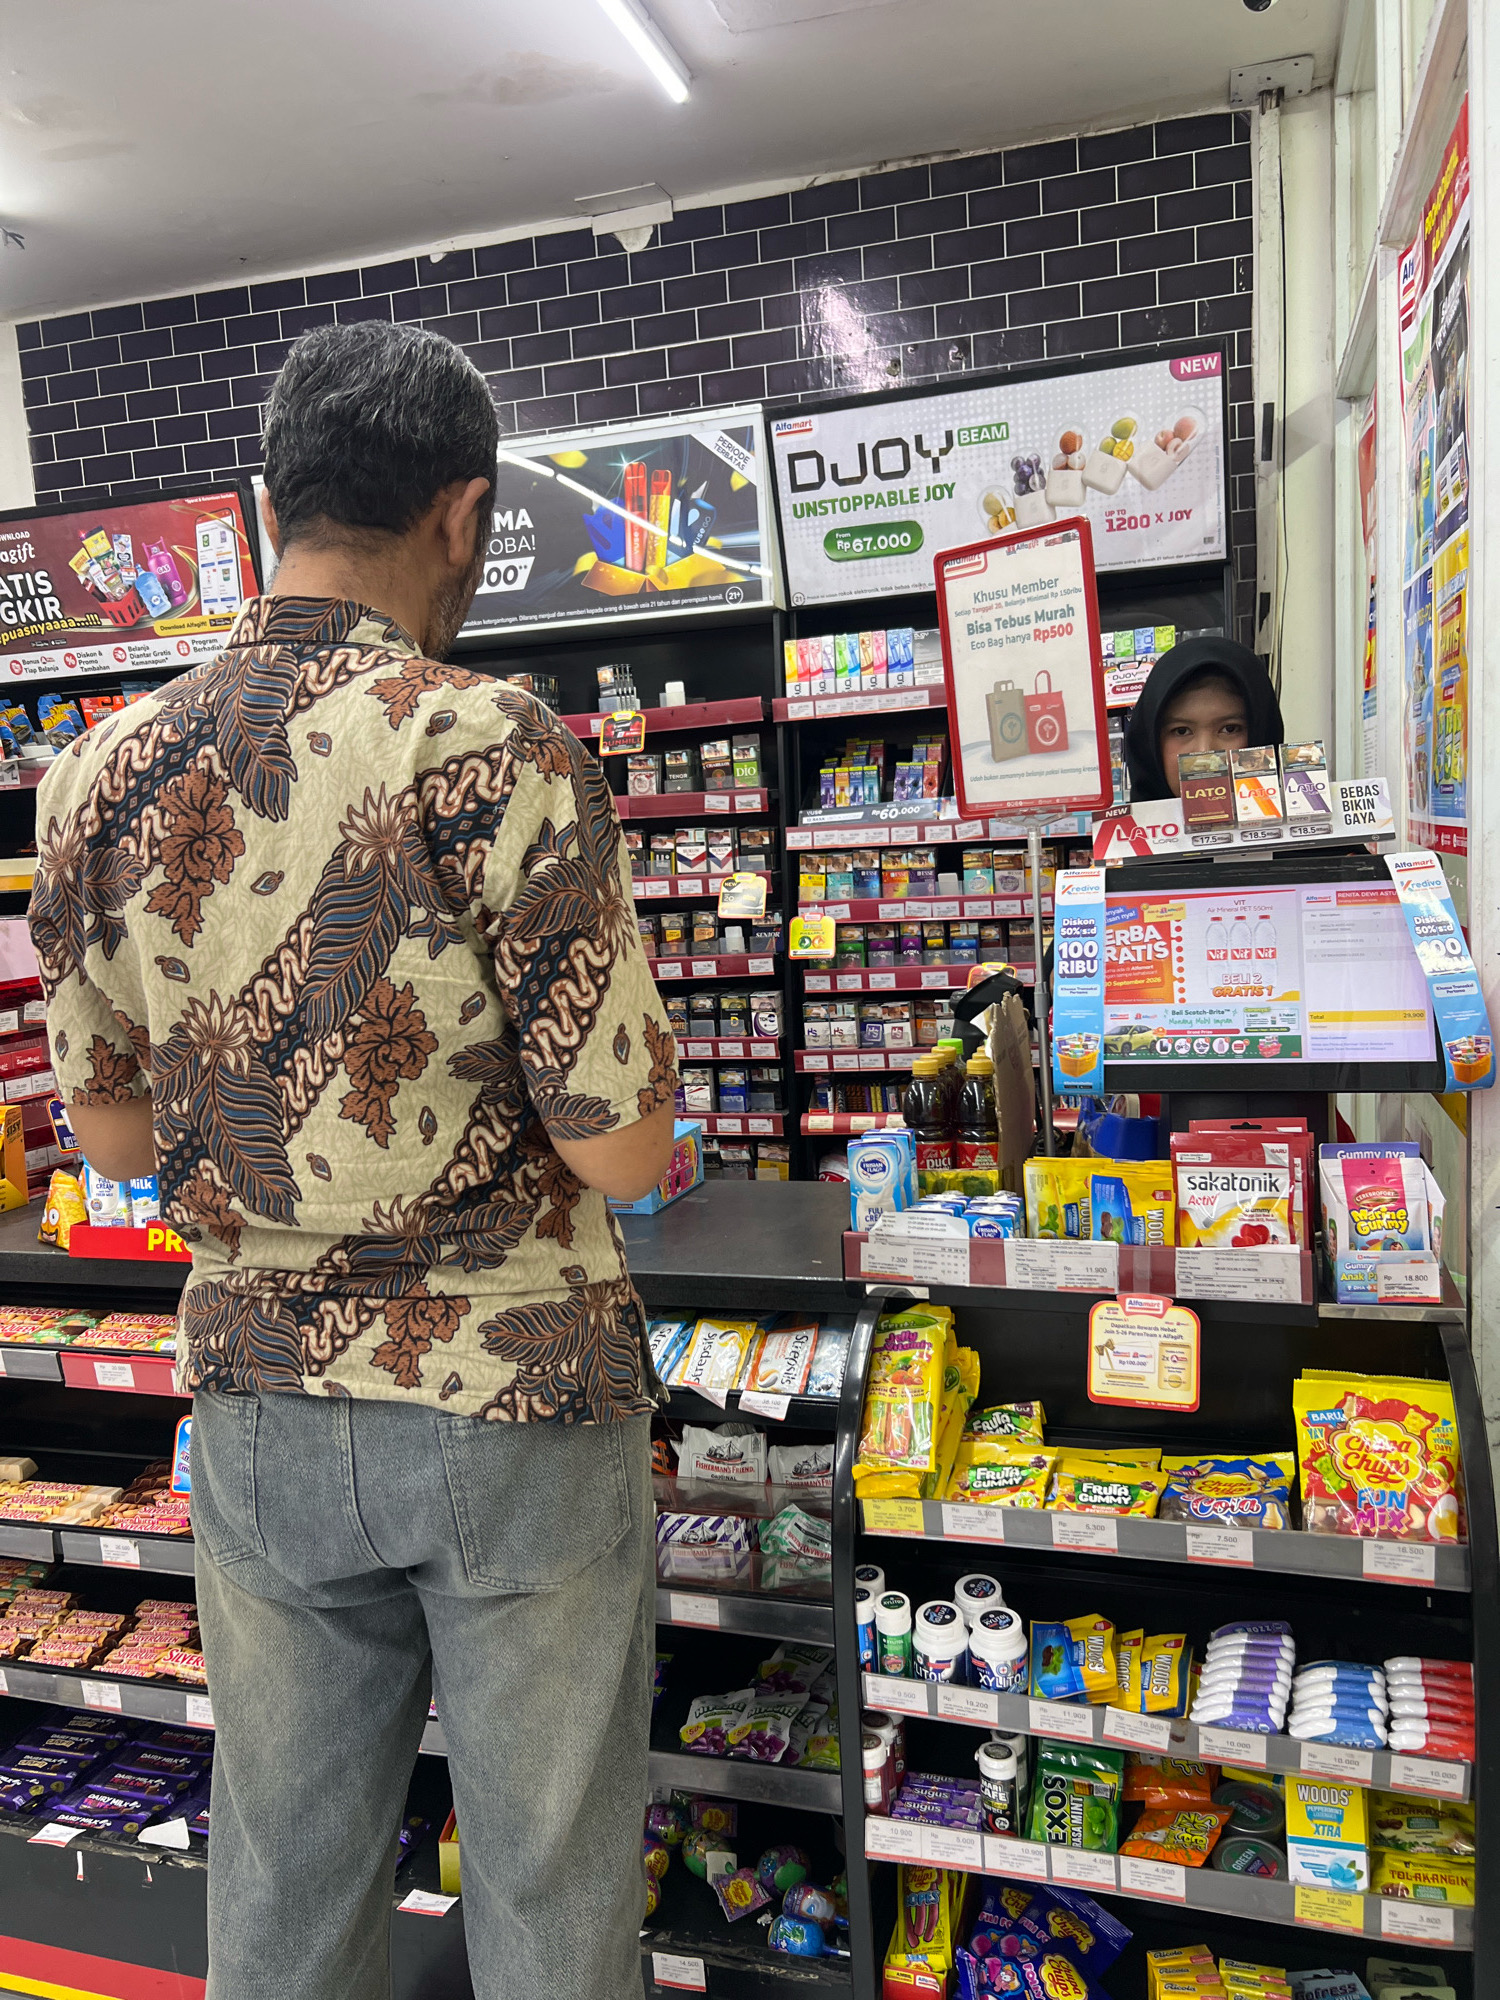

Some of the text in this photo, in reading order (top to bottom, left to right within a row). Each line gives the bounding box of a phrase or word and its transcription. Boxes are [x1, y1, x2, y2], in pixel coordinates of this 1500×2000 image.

[1178, 356, 1219, 375] NEW
[716, 434, 751, 465] PERIODE
[712, 442, 747, 472] TERBATAS
[787, 423, 1008, 494] DJOY BEAM
[791, 481, 957, 520] UNSTOPPABLE JOY
[1104, 508, 1194, 533] 1200 JOY
[156, 564, 170, 575] GAS
[973, 577, 1060, 604] Khusu Member
[954, 607, 972, 618] Setiap
[1004, 598, 1026, 608] Belanja
[1060, 587, 1082, 596] 150ribu
[967, 604, 1075, 636] Bisa Tebus Murah
[970, 622, 1074, 650] Eco Bag hanya Rp500
[191, 638, 219, 648] Program
[127, 645, 150, 655] Belanja
[192, 644, 224, 654] Berhadiah
[76, 651, 98, 659] Diskon
[129, 650, 172, 660] Diantar Gratis
[24, 667, 38, 675] Tiap
[80, 664, 111, 673] Tambahan
[735, 766, 756, 778] DIO
[1186, 786, 1227, 799] LATO
[1239, 787, 1277, 799] LATO
[1288, 782, 1326, 793] LATO
[1340, 784, 1381, 800] BEBAS
[1342, 799, 1376, 813] BIKIN
[1105, 806, 1129, 818] NEW
[1344, 812, 1377, 827] GAYA
[1248, 832, 1267, 840] 18.5
[1297, 827, 1316, 835] 18.5
[1200, 836, 1217, 844] 17.5
[1394, 858, 1434, 870] Alfamart
[1360, 890, 1379, 898] DEWI
[1120, 910, 1136, 920] nya!
[1062, 917, 1095, 926] Diskon
[1060, 926, 1081, 936] 50%
[1415, 924, 1437, 935] 50%
[1058, 940, 1099, 959] 100
[1232, 949, 1251, 960] Vit
[1257, 947, 1275, 959] Vit
[1208, 950, 1226, 961] Vit
[1058, 959, 1099, 975] RIBU
[1113, 978, 1145, 987] September
[1222, 973, 1263, 985] BELI 2
[1212, 985, 1273, 998] GRATIS 1
[1336, 1150, 1382, 1160] Gummy
[863, 1160, 884, 1170] FRISIAN
[866, 1165, 884, 1174] FLAG
[97, 1176, 112, 1185] FULL
[1187, 1172, 1280, 1193] sakatonik
[95, 1182, 115, 1191] CREAM
[868, 1207, 884, 1216] FULL
[1350, 1206, 1407, 1222] Marine
[1355, 1218, 1410, 1236] Gummy
[890, 1256, 908, 1264] 7.300
[1084, 1266, 1108, 1274] 11.900
[1344, 1261, 1376, 1272] Gummy
[1340, 1272, 1367, 1282] Anak
[1383, 1273, 1429, 1282] Rp 18.800
[1127, 1299, 1161, 1308] Alfamart
[79, 1327, 157, 1342] SILVERQUEEN
[780, 1333, 810, 1387] Strepsils
[1311, 1411, 1342, 1422] BARU
[1306, 1427, 1325, 1440] YAY
[695, 1459, 733, 1474] FISHERMAN'S
[1167, 1469, 1198, 1477] BARU
[972, 1476, 1023, 1490] GUMMY
[1078, 1492, 1132, 1506] GUMMY
[1356, 1487, 1407, 1511] FUN
[1188, 1495, 1262, 1518] Cola
[1085, 1523, 1106, 1532] 5.300
[1216, 1535, 1238, 1543] 7.500
[883, 1597, 905, 1606] XYLITOL
[130, 1634, 180, 1644] SILVERQUEEN
[114, 1772, 155, 1786] DAIRY MILK
[919, 1773, 954, 1784] sugus
[913, 1787, 949, 1799] sugus
[1296, 1783, 1353, 1807] WOODS'
[88, 1792, 129, 1808] DAIRY MILK
[904, 1801, 942, 1814] sugus
[1306, 1805, 1343, 1816] PEPPERMINT
[57, 1812, 98, 1826] DAIRY MILK
[1069, 1793, 1084, 1849] RASA MINT
[890, 1827, 913, 1837] 10.900
[1312, 1822, 1343, 1839] XTRA
[956, 1836, 975, 1845] 5.000
[1091, 1856, 1113, 1866] 4.000
[1153, 1866, 1176, 1876] 4.500
[1153, 1950, 1183, 1960] Ricola
[1158, 1966, 1191, 1976] Ricola
[1163, 1982, 1198, 1993] Ricola
